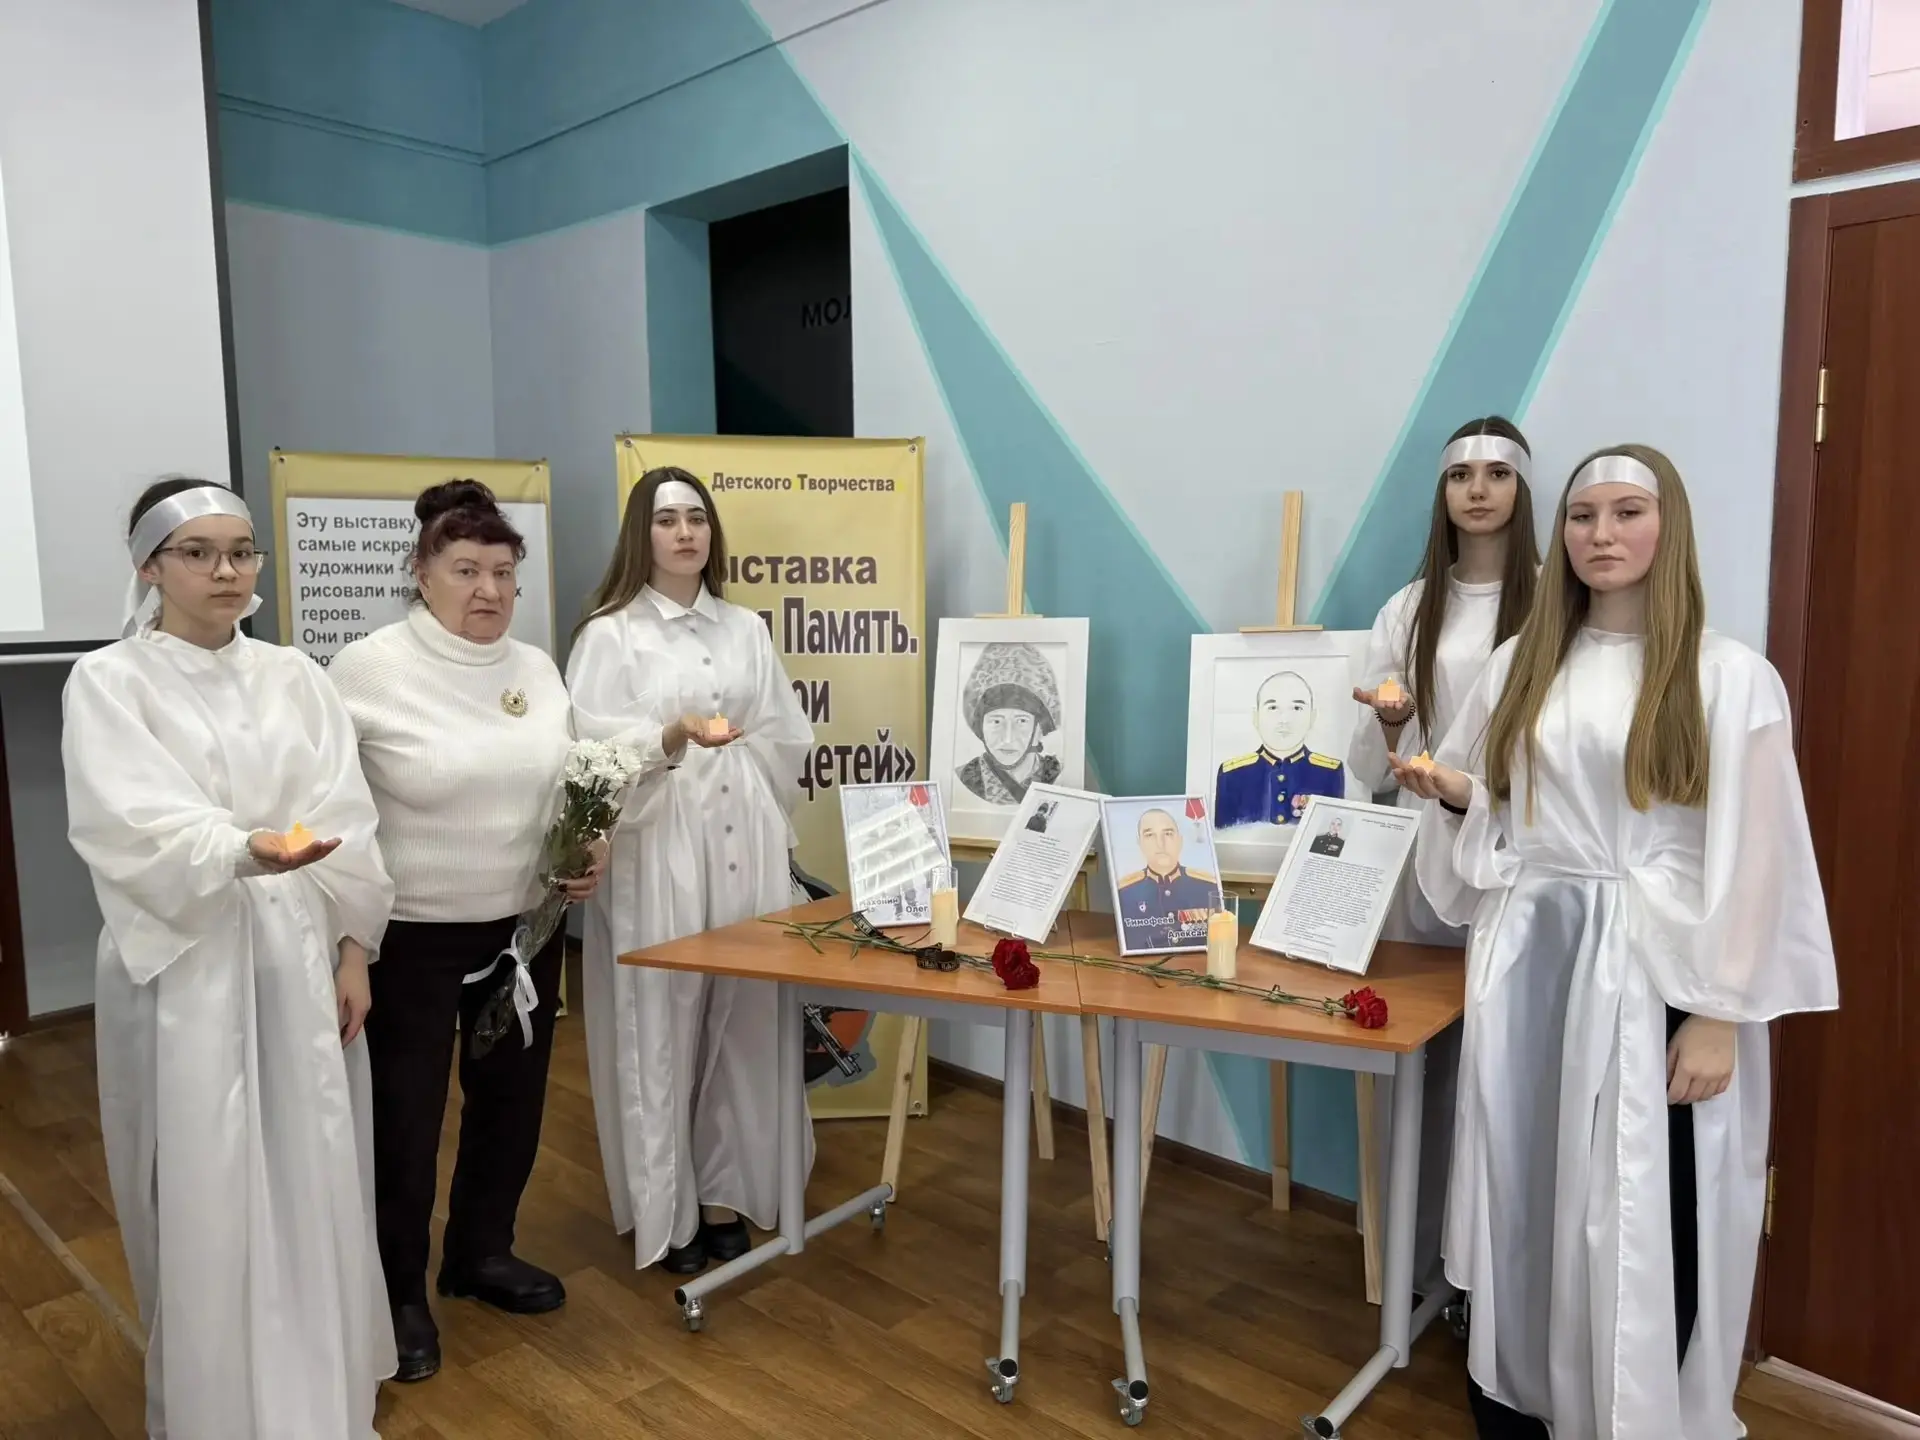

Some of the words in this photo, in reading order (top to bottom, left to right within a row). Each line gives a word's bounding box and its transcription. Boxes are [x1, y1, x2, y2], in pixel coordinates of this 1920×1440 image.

[711, 472, 792, 492] Детского
[797, 474, 895, 494] Творчества
[297, 512, 328, 532] Эту
[334, 515, 417, 533] выставку
[298, 538, 357, 552] самые
[299, 561, 394, 577] художники
[301, 583, 386, 601] рисовали
[302, 609, 366, 622] героев.
[783, 597, 918, 655] Память.
[303, 628, 338, 644] Они
